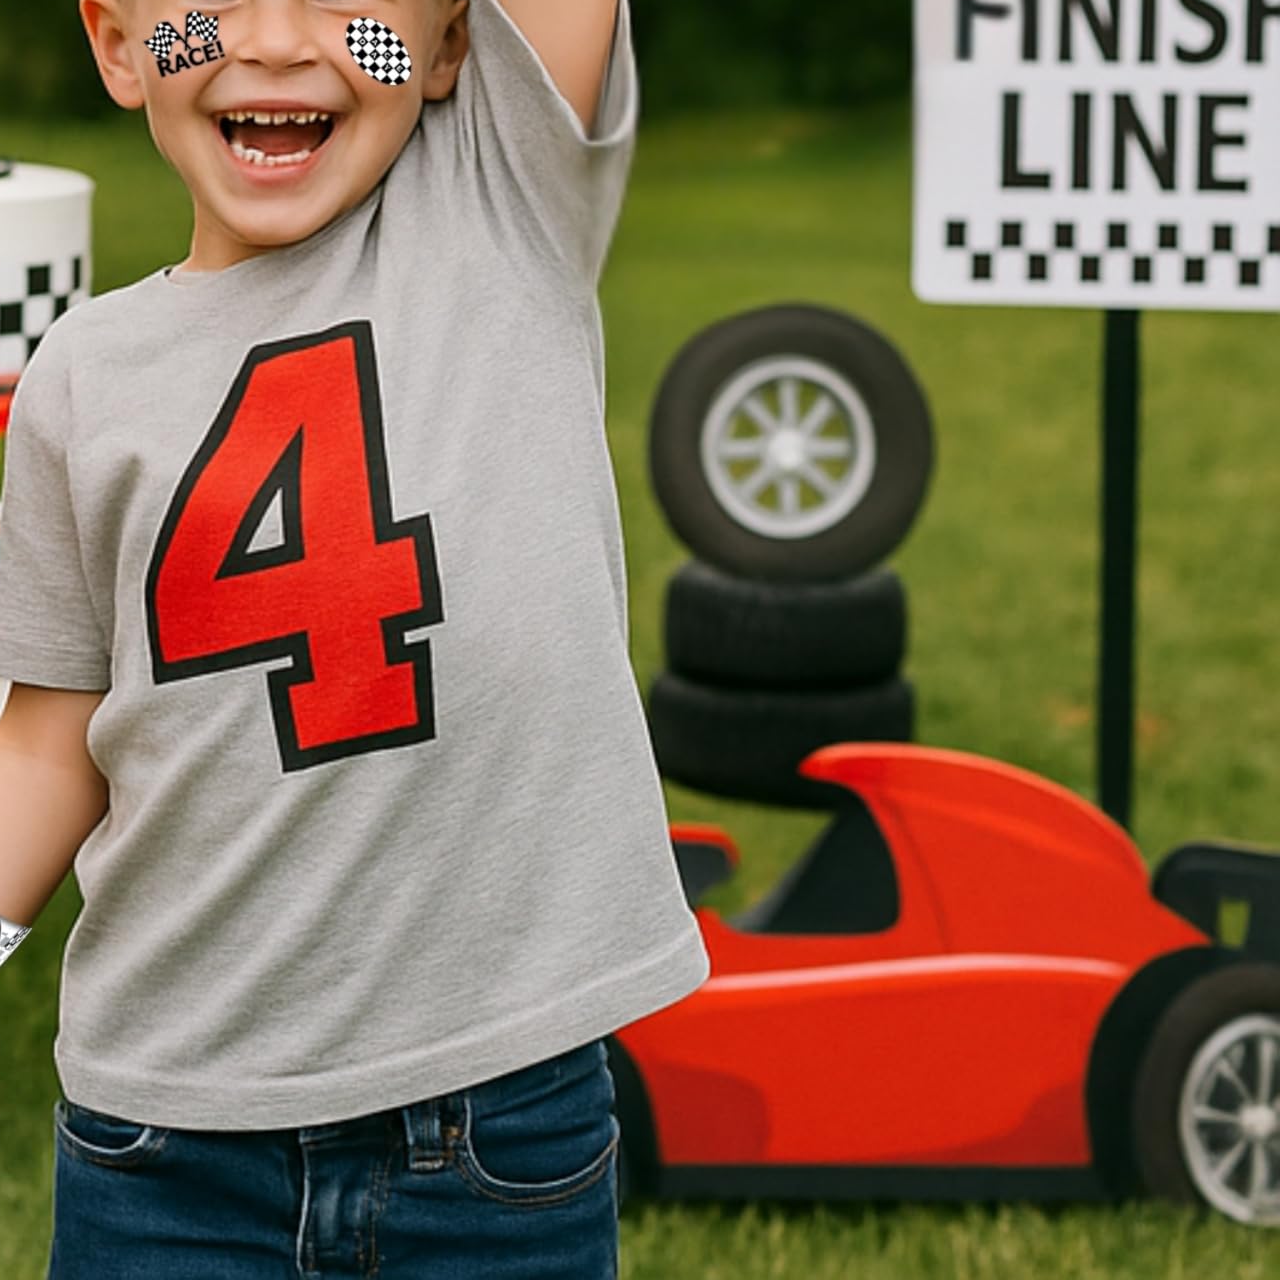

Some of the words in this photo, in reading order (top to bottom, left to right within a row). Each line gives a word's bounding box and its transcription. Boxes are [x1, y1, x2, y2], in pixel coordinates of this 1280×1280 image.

[157, 40, 226, 77] RACE!
[1000, 91, 1250, 193] LINE
[146, 319, 446, 773] 4
